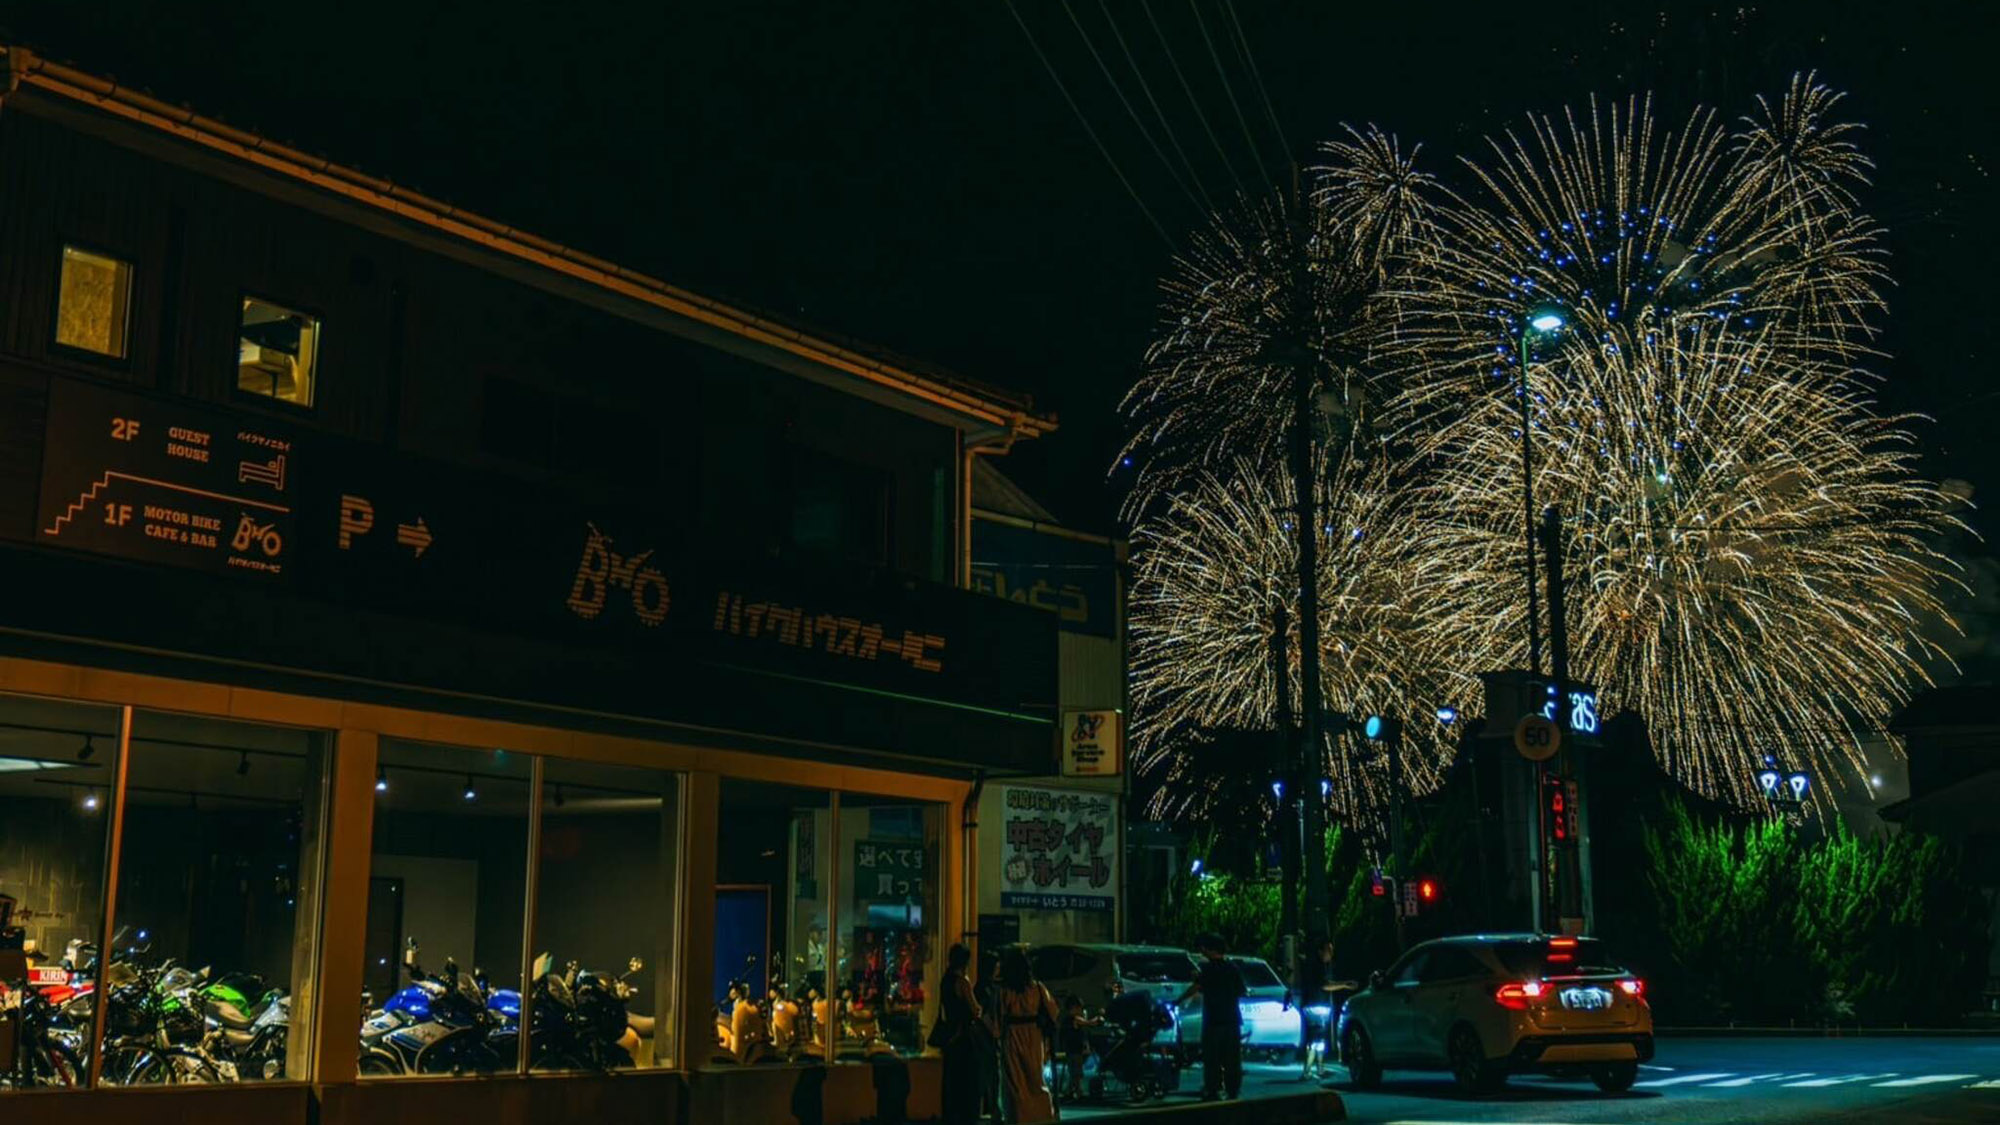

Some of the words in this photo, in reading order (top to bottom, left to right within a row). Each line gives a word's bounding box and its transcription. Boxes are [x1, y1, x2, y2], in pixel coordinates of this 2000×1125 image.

[111, 417, 140, 441] 2F
[168, 426, 211, 446] GUEST
[167, 442, 210, 463] HOUSE
[104, 503, 133, 527] 1F
[144, 505, 188, 525] MOTOR
[191, 512, 221, 531] BIKE
[337, 493, 375, 551] P
[144, 523, 178, 541] CAFE
[180, 532, 188, 544] &
[190, 533, 217, 549] BAR
[1525, 727, 1550, 746] 50
[1007, 816, 1104, 854] 中古タイヤ
[1032, 854, 1110, 888] ホイール
